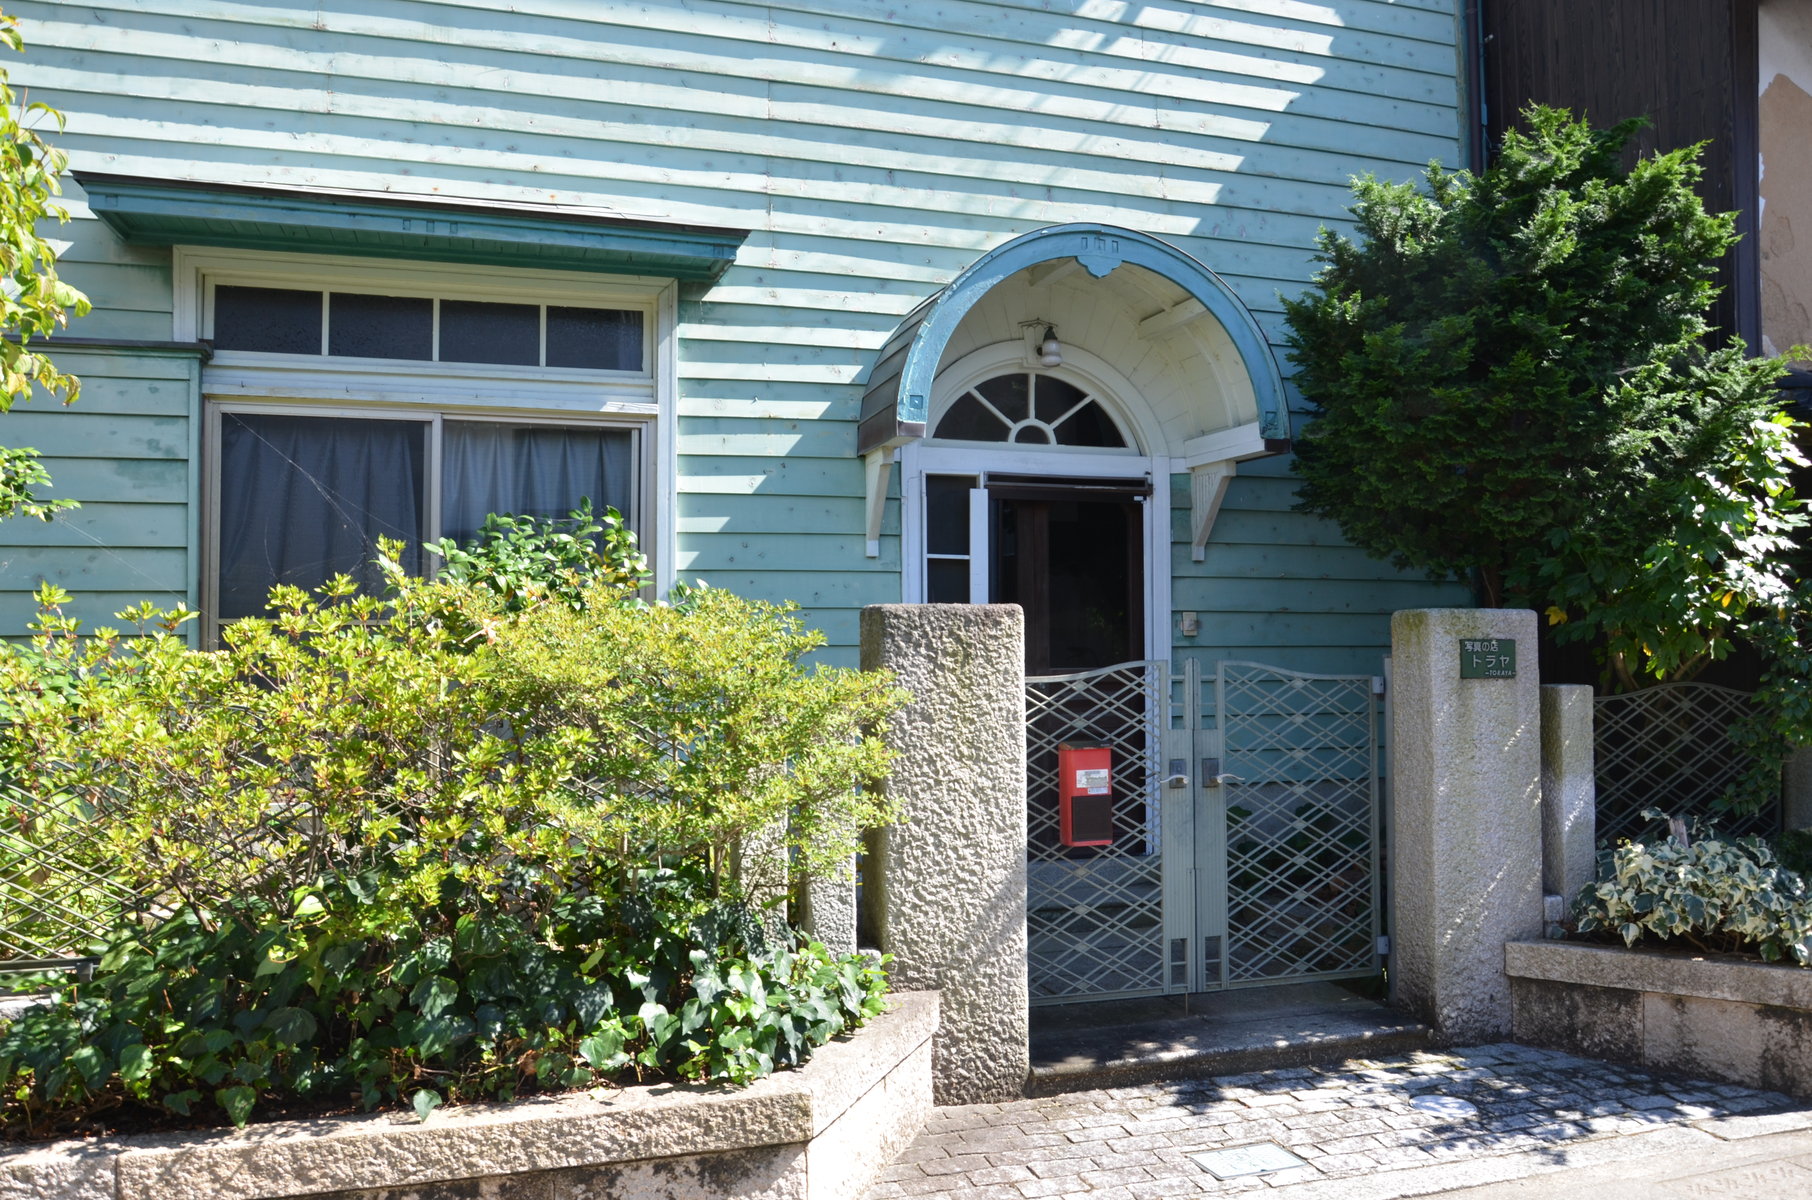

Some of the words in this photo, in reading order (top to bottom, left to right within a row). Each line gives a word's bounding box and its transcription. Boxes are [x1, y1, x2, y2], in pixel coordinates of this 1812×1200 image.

[1464, 640, 1498, 652] 写真の店
[1473, 654, 1510, 668] トラヤ
